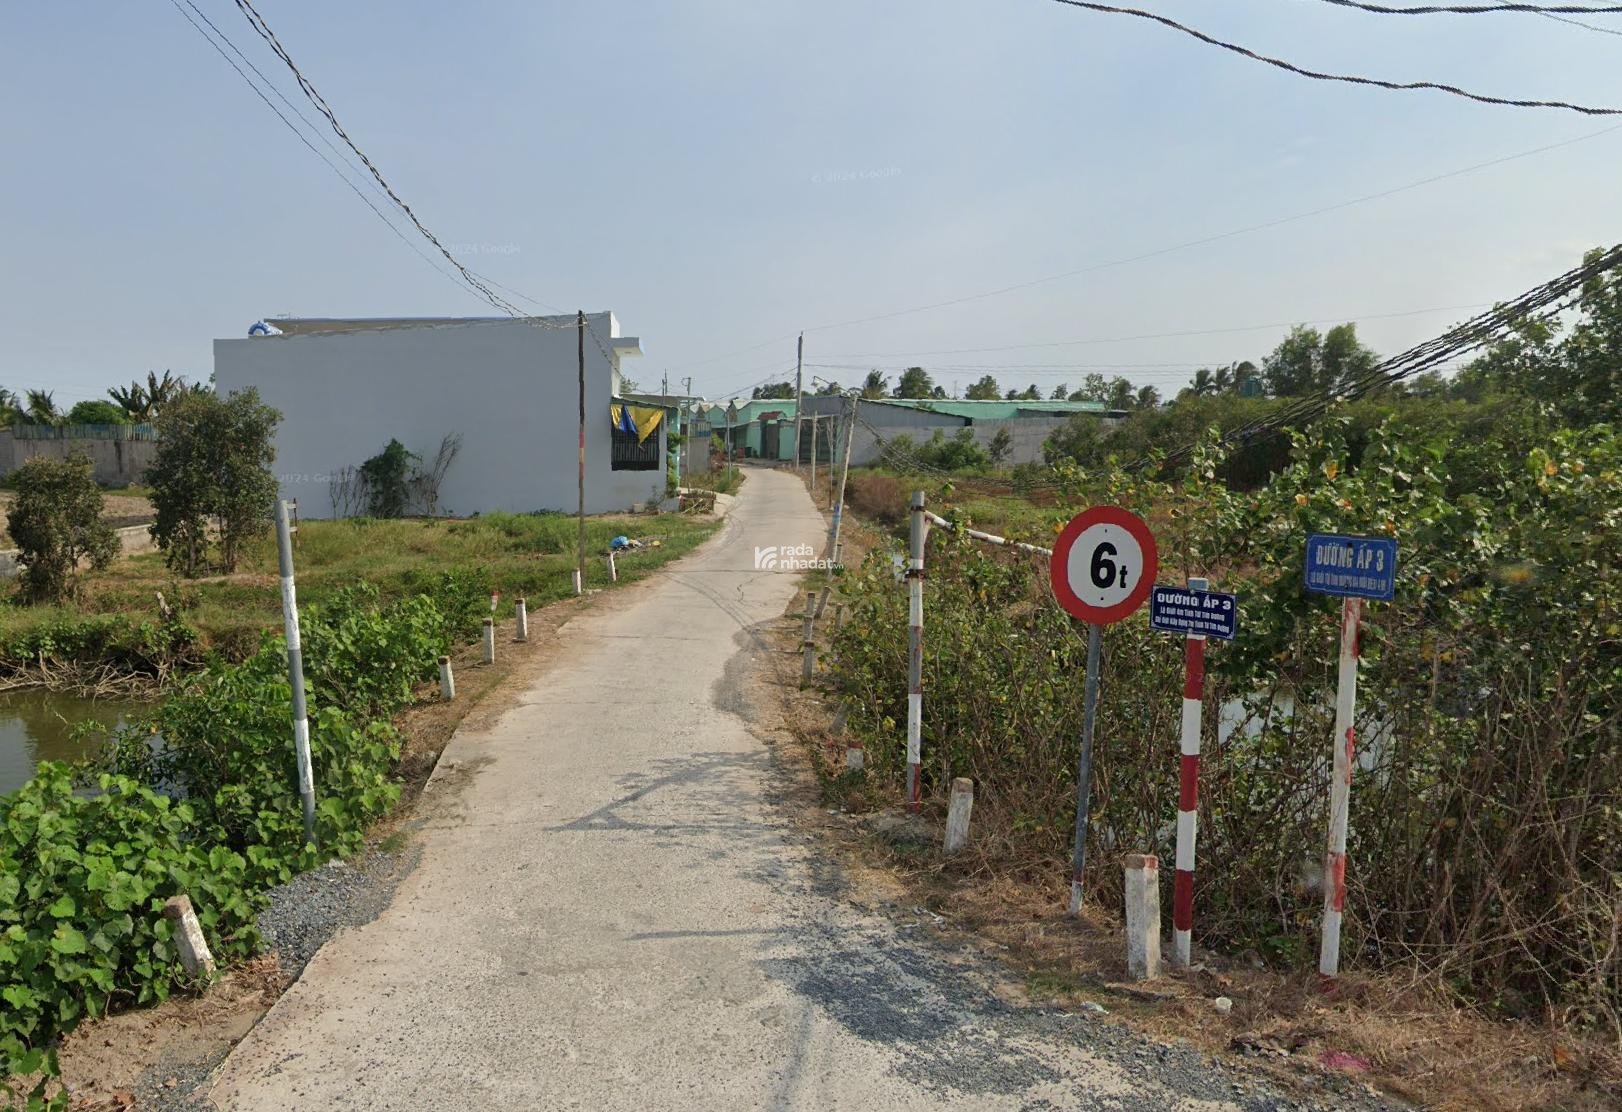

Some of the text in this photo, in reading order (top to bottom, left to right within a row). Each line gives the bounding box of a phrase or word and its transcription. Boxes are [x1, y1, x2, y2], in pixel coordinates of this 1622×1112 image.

[1315, 542, 1384, 572] ĐƯỜNG ẤP 3
[1157, 593, 1199, 607] ĐƯỜNG
[1222, 600, 1231, 610] 3
